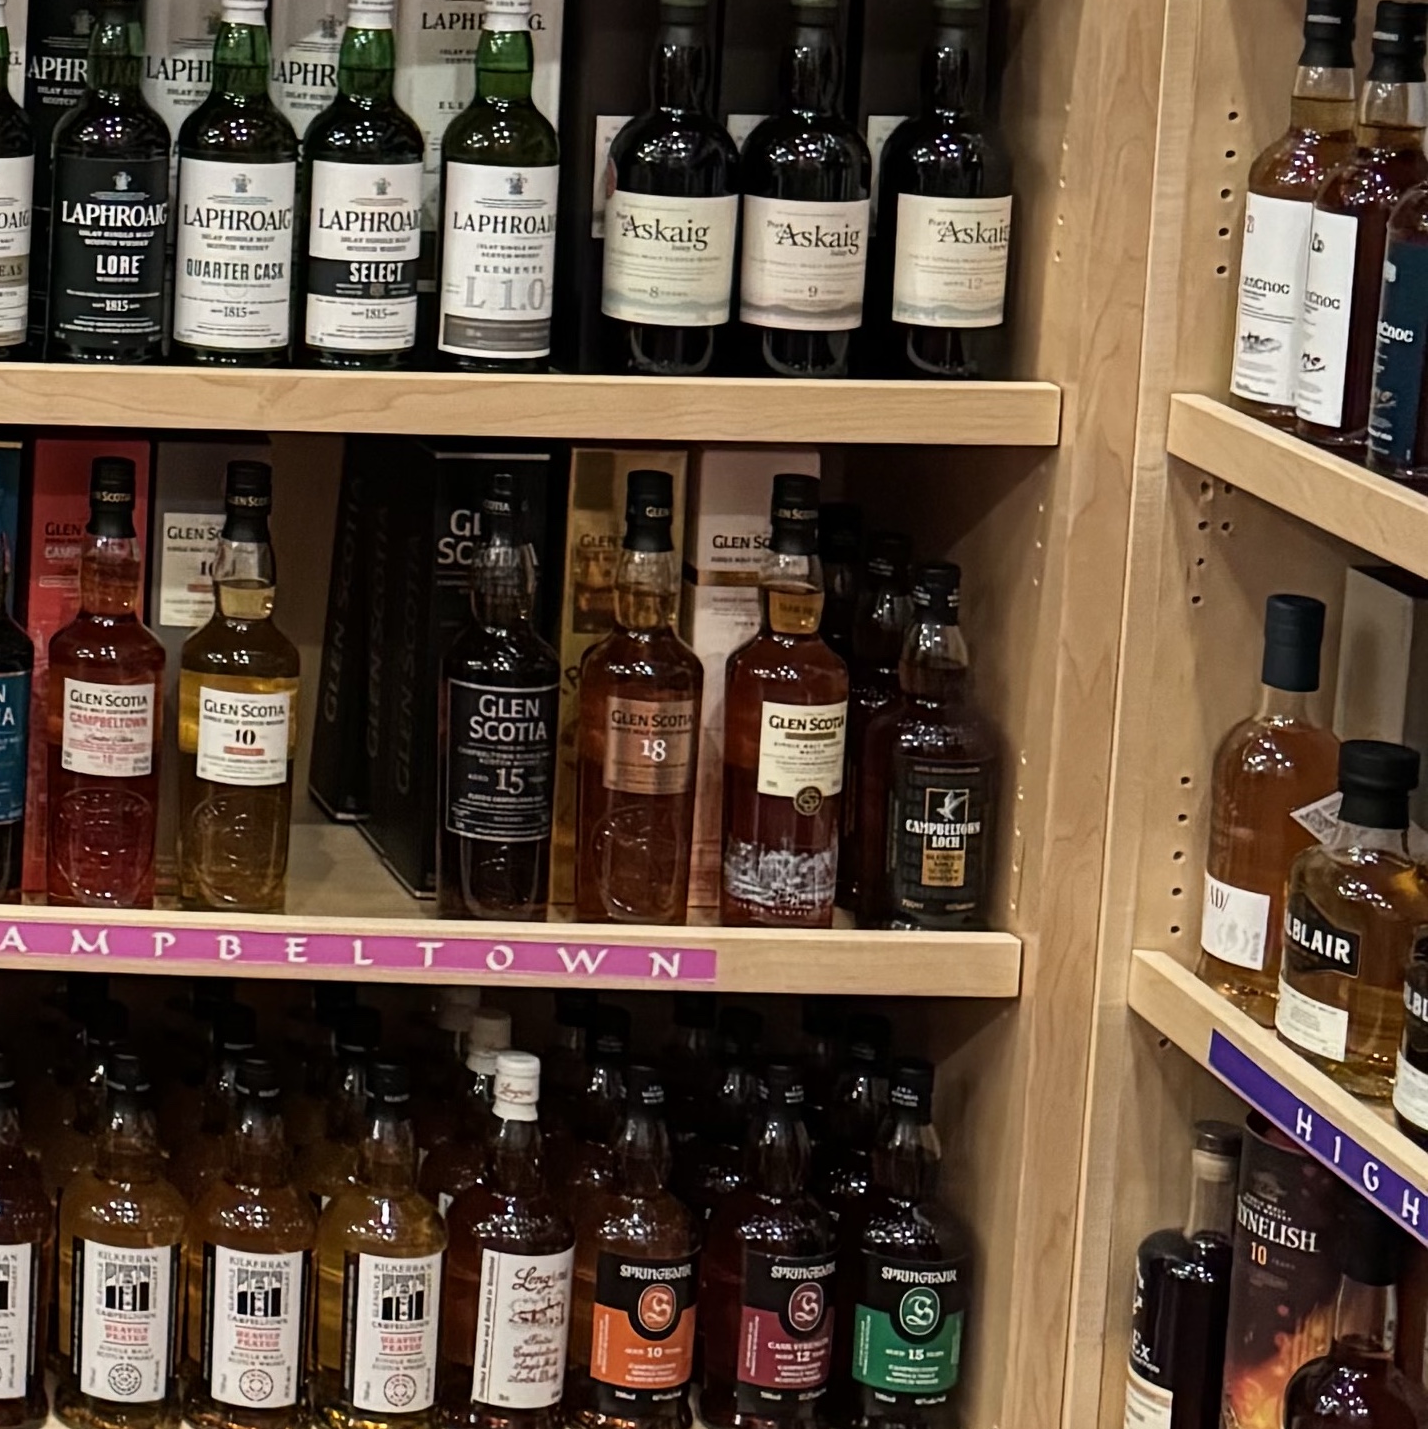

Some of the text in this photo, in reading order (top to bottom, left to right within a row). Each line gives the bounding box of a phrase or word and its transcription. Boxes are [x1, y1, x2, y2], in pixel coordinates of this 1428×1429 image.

[96, 255, 141, 275] LORE
[186, 257, 284, 282] QUARTER CASK
[349, 262, 403, 283] SELECT
[648, 284, 660, 299] 8
[105, 300, 129, 312] 1815
[224, 306, 248, 318] 1815
[364, 307, 388, 319] 1815
[70, 689, 148, 708] GLEN SCOTIA
[478, 693, 541, 719] GLEN
[203, 698, 285, 718] GLEN SCOTIA
[610, 709, 650, 727] GLEN
[769, 714, 806, 732] GLEN
[234, 729, 256, 745] 10
[468, 716, 547, 742] SCOTIA
[640, 739, 667, 763] 18
[495, 768, 525, 795] 15
[932, 836, 960, 848] LOCH
[97, 1250, 159, 1264] KILKERRAN
[1251, 1241, 1267, 1265] 10
[228, 1256, 291, 1270] KILKERRAN
[373, 1262, 434, 1273] KILKERRAN
[881, 1266, 957, 1284] SPRINGBANK
[646, 1346, 662, 1358] 10
[796, 1351, 811, 1363] 12
[908, 1349, 924, 1361] 15
